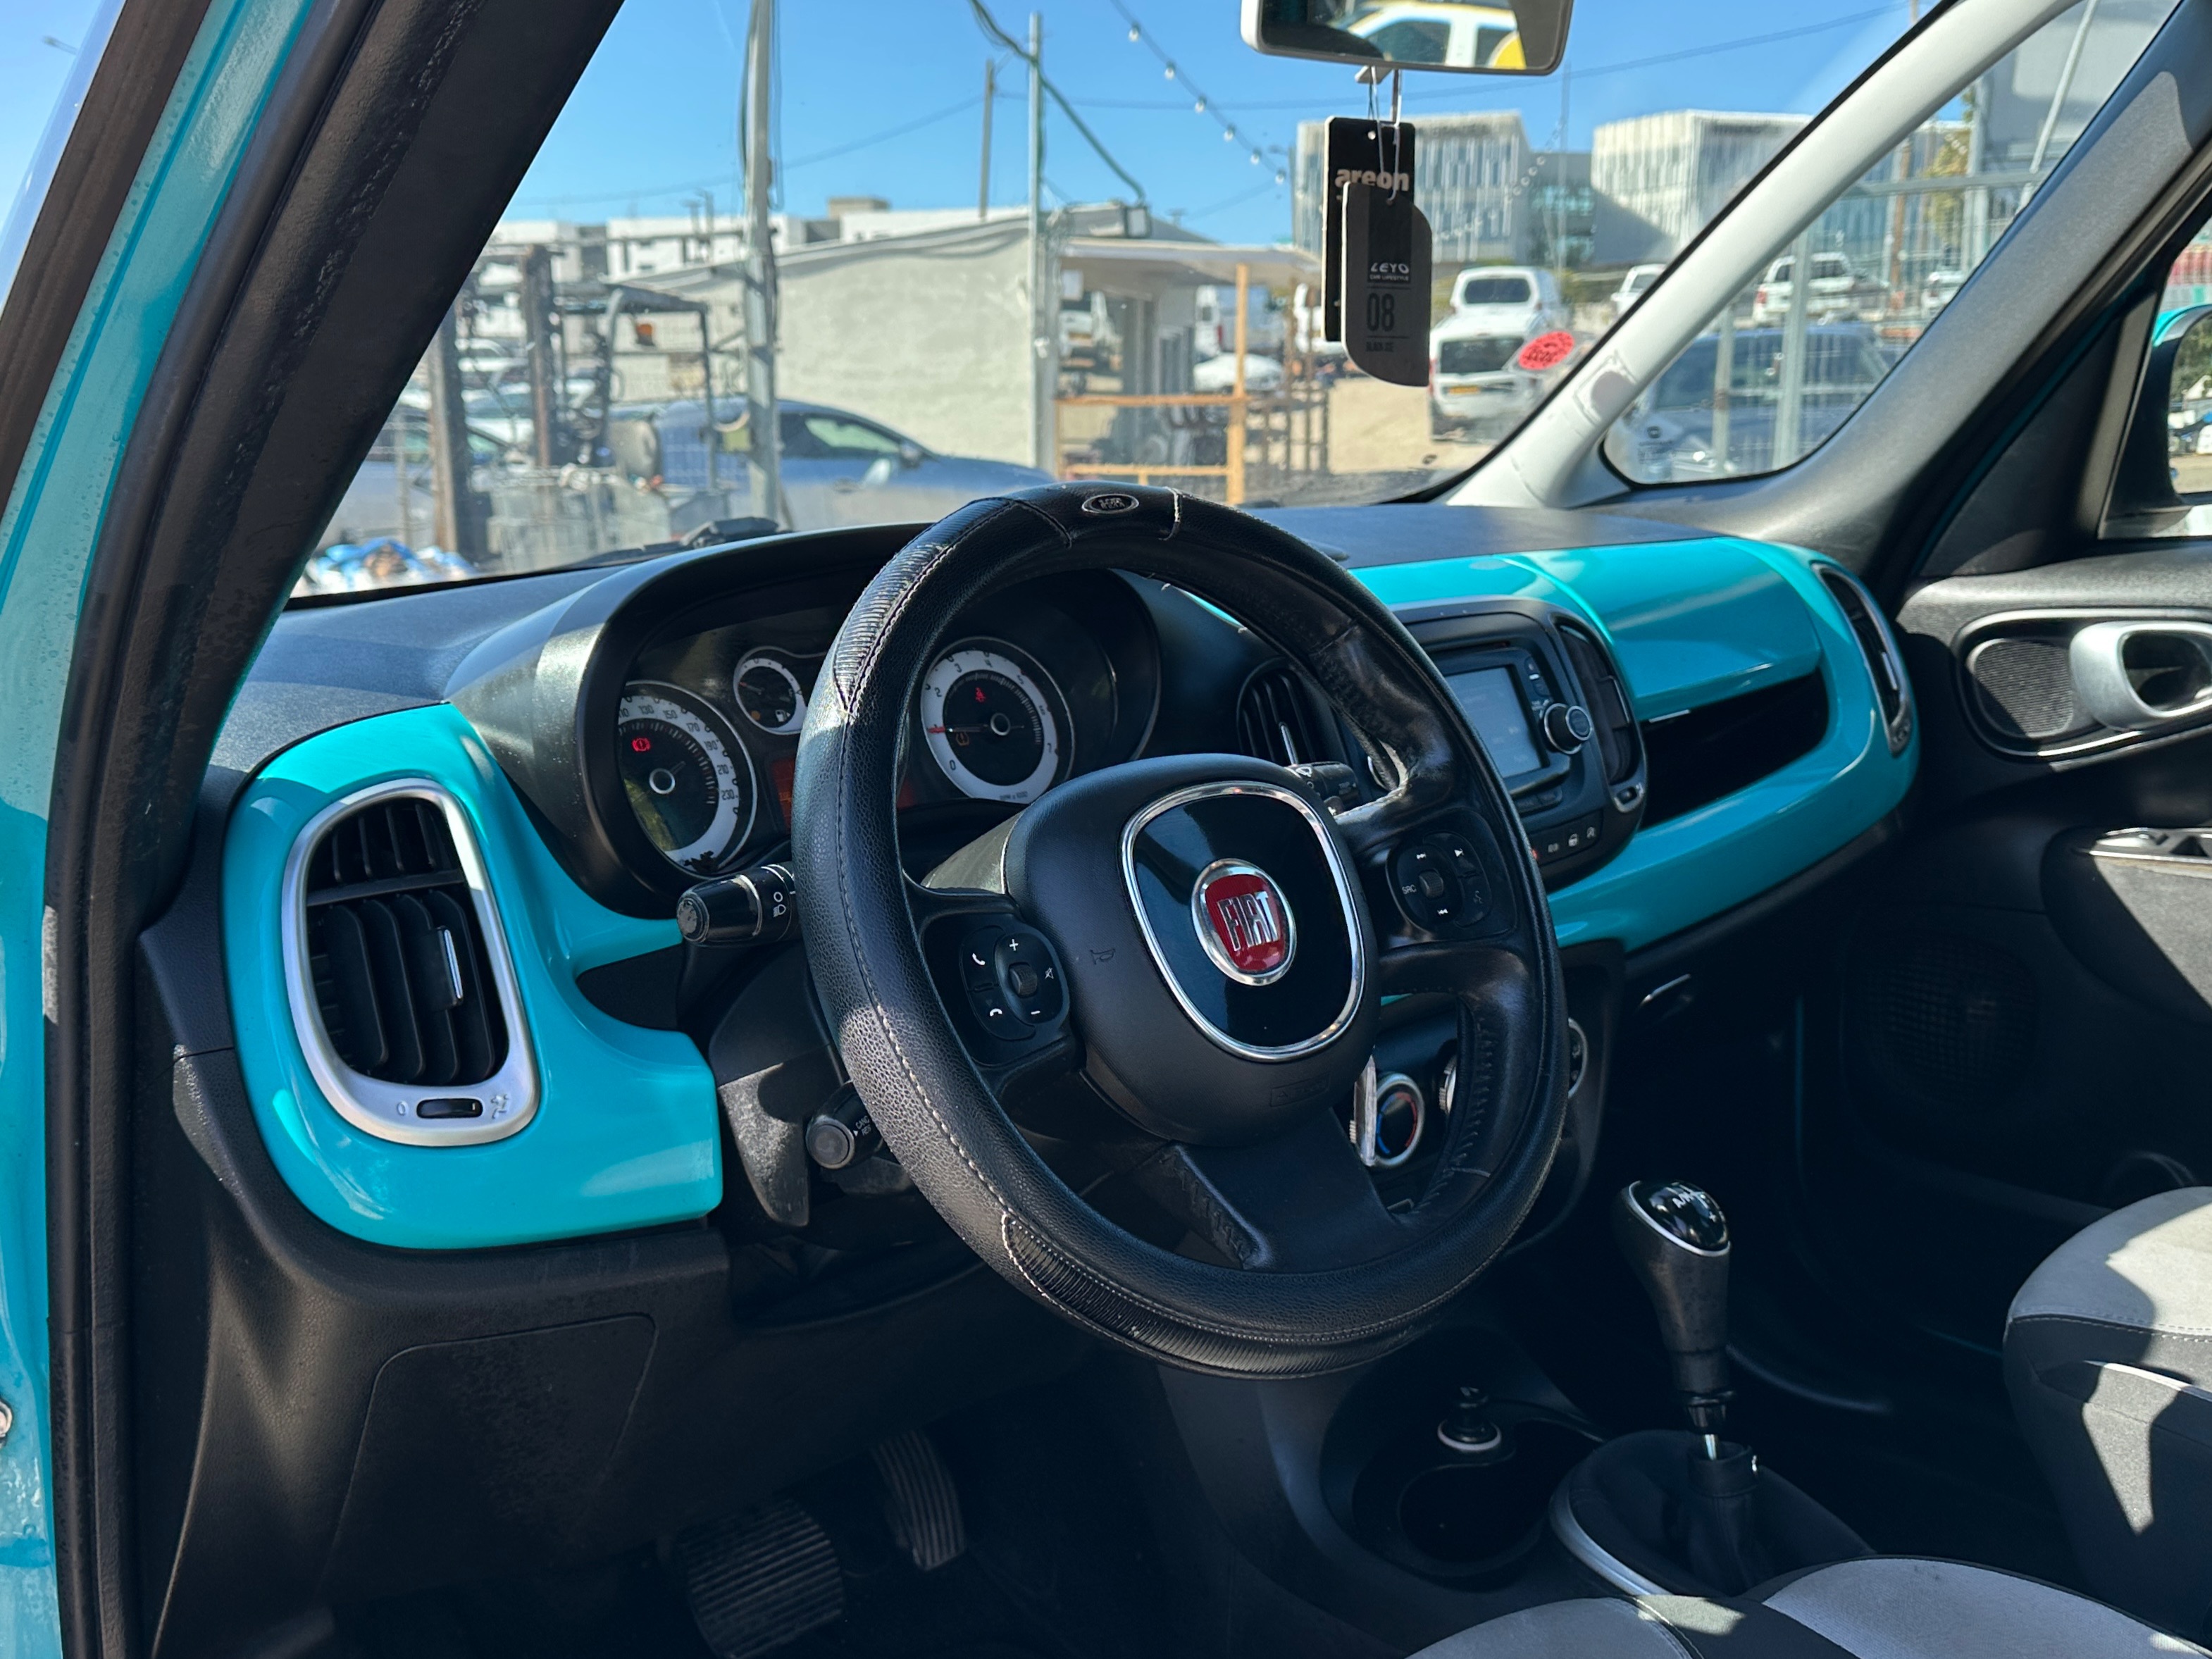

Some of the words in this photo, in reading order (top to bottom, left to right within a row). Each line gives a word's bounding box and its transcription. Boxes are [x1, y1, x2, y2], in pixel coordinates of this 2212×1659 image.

[1335, 169, 1408, 191] areon
[1367, 292, 1394, 332] 08
[1401, 884, 1417, 895] SRC
[1216, 890, 1280, 952] FIAT
